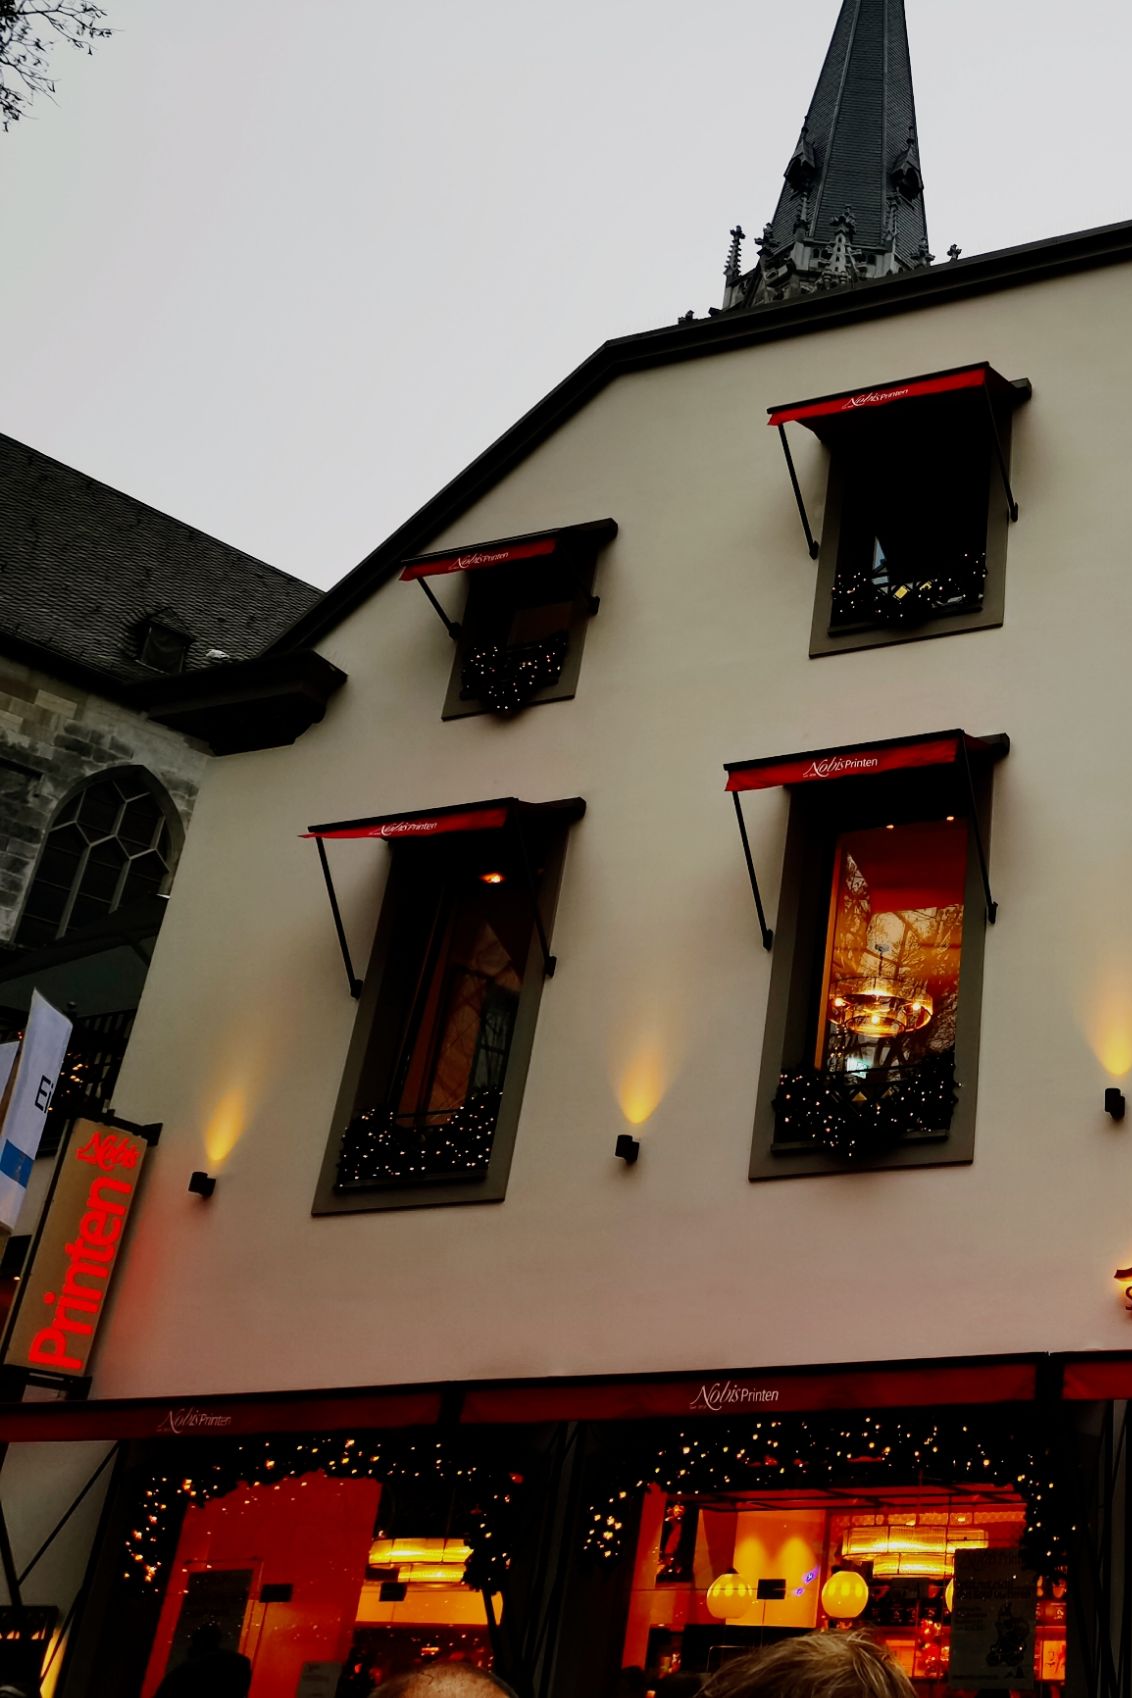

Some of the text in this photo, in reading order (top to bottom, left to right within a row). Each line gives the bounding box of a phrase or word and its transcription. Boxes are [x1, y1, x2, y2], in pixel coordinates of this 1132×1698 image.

[803, 757, 878, 777] Nobis Printen
[29, 1176, 134, 1370] Printen
[689, 1380, 779, 1411] Nobis Printen
